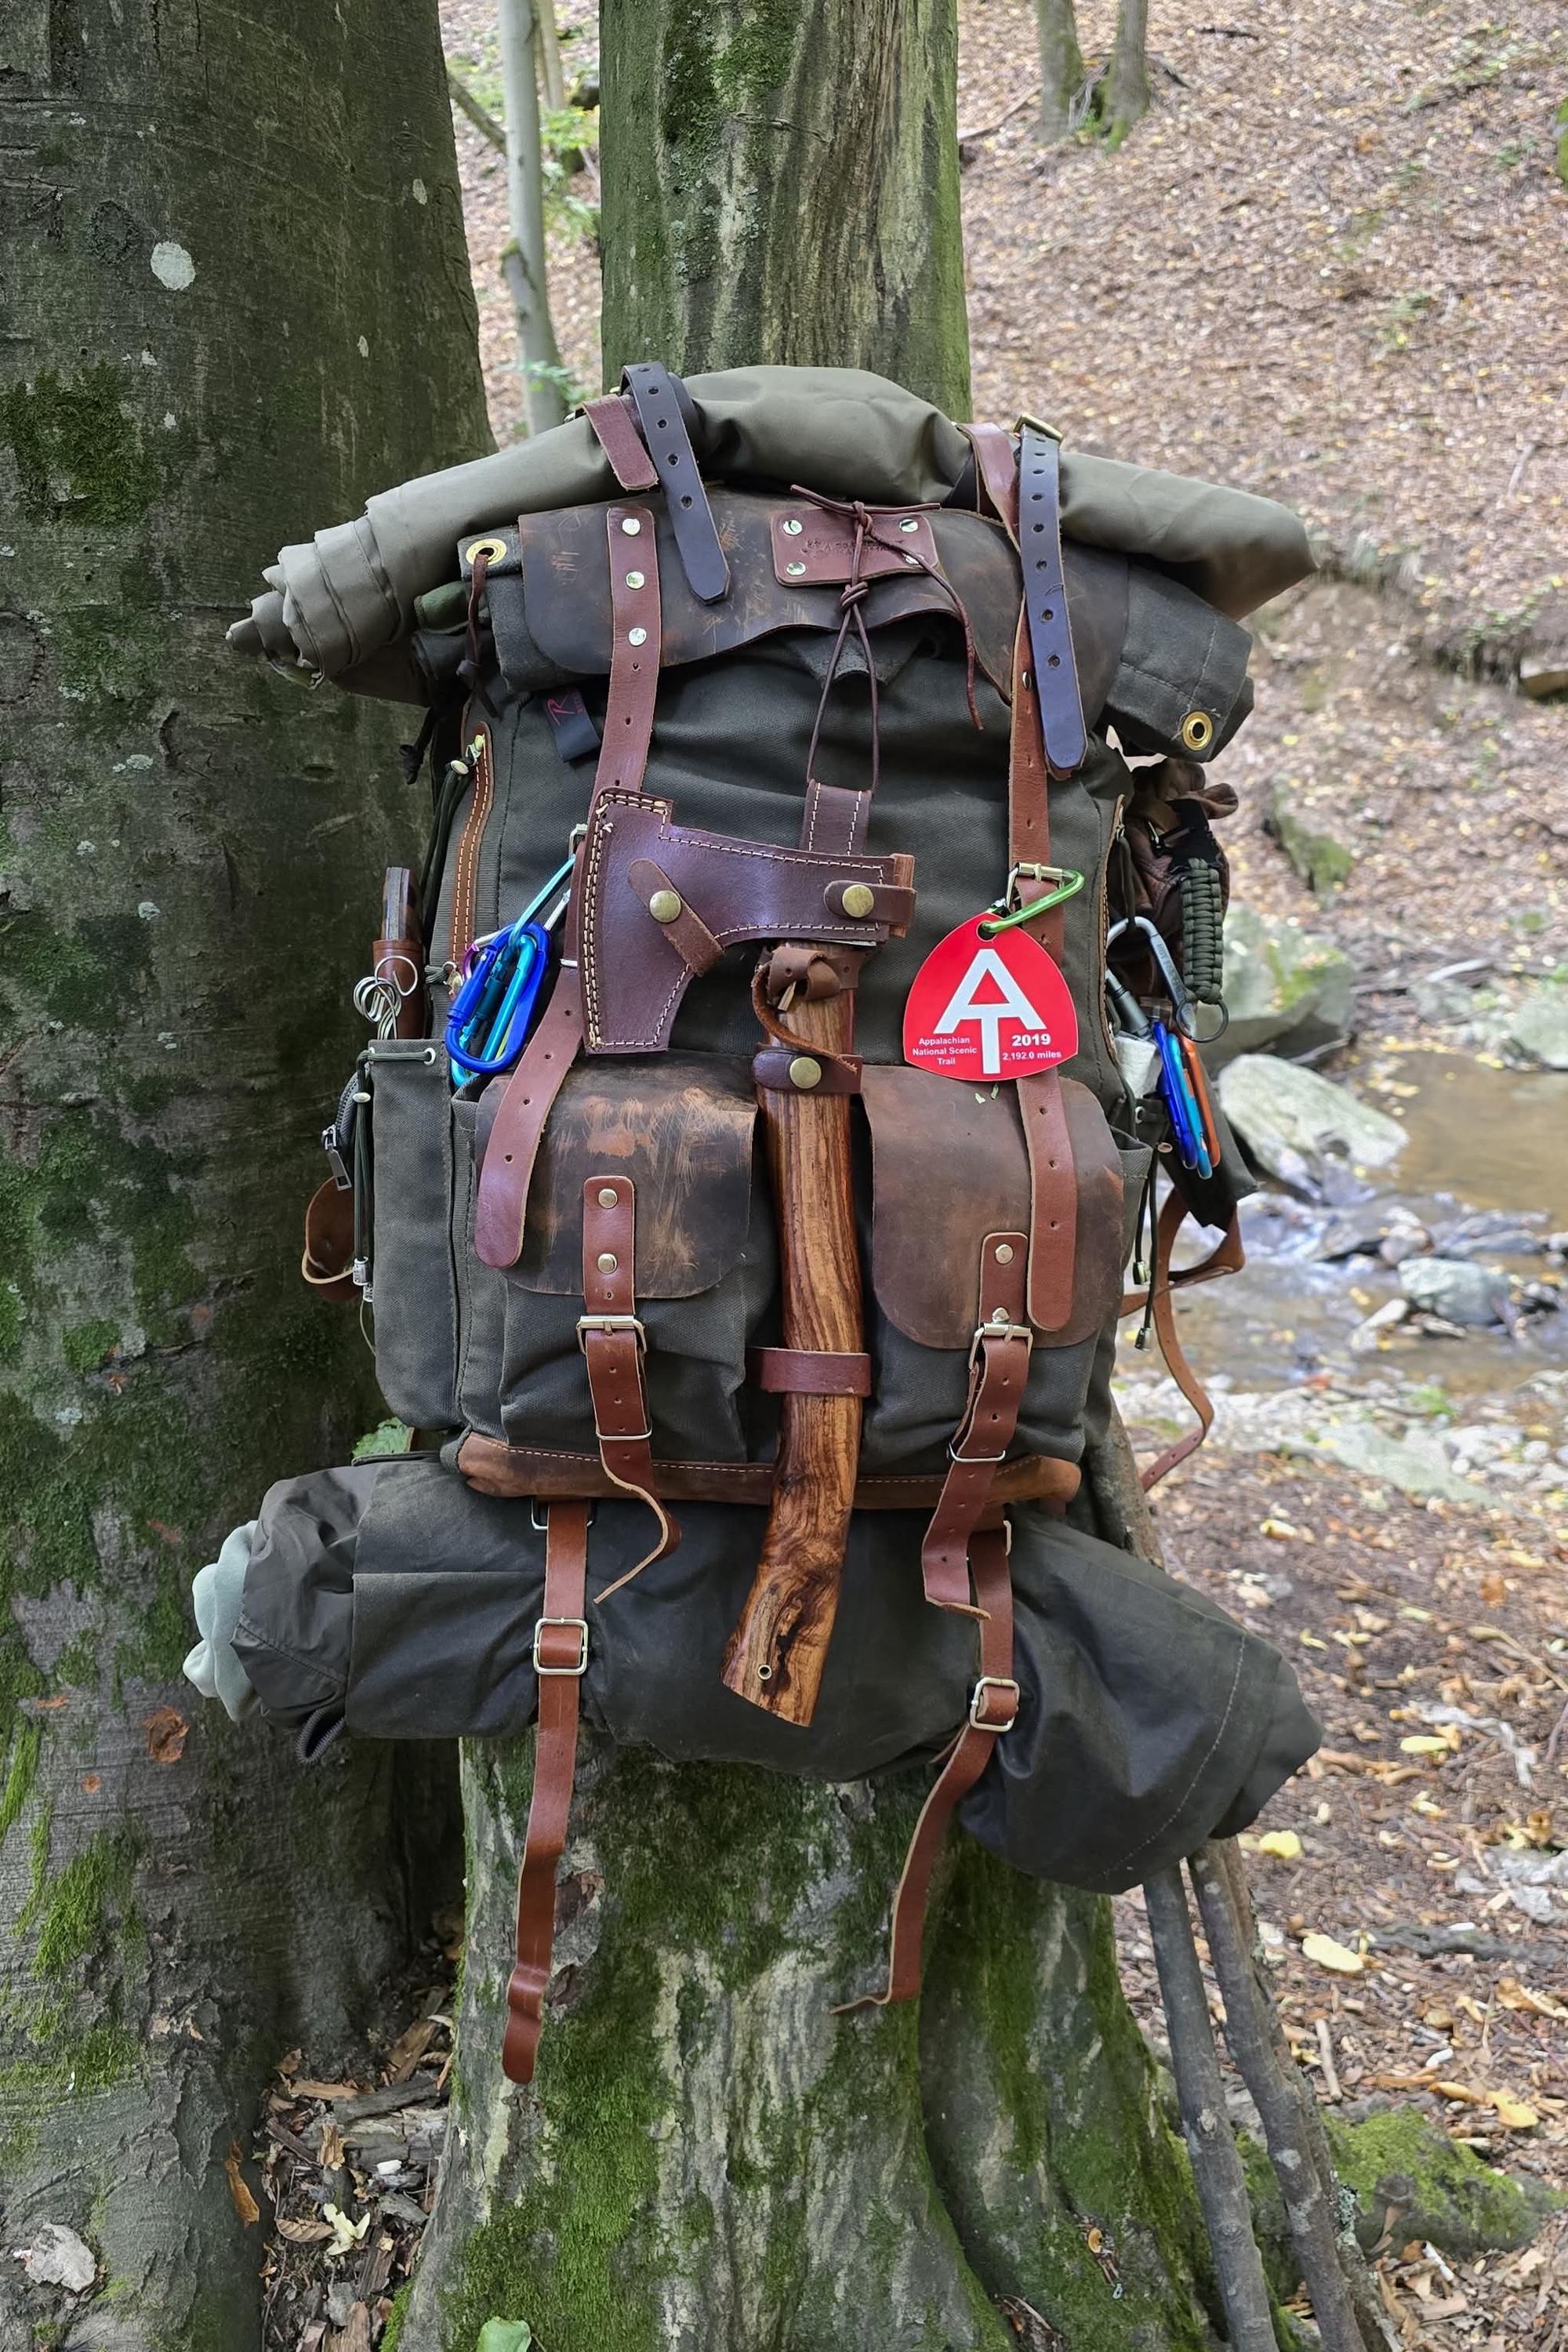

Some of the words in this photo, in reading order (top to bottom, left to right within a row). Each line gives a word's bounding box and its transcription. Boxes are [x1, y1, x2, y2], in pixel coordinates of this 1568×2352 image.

[919, 1036, 970, 1046] Appalachian
[1011, 1033, 1051, 1047] 2019
[912, 1047, 947, 1056] National
